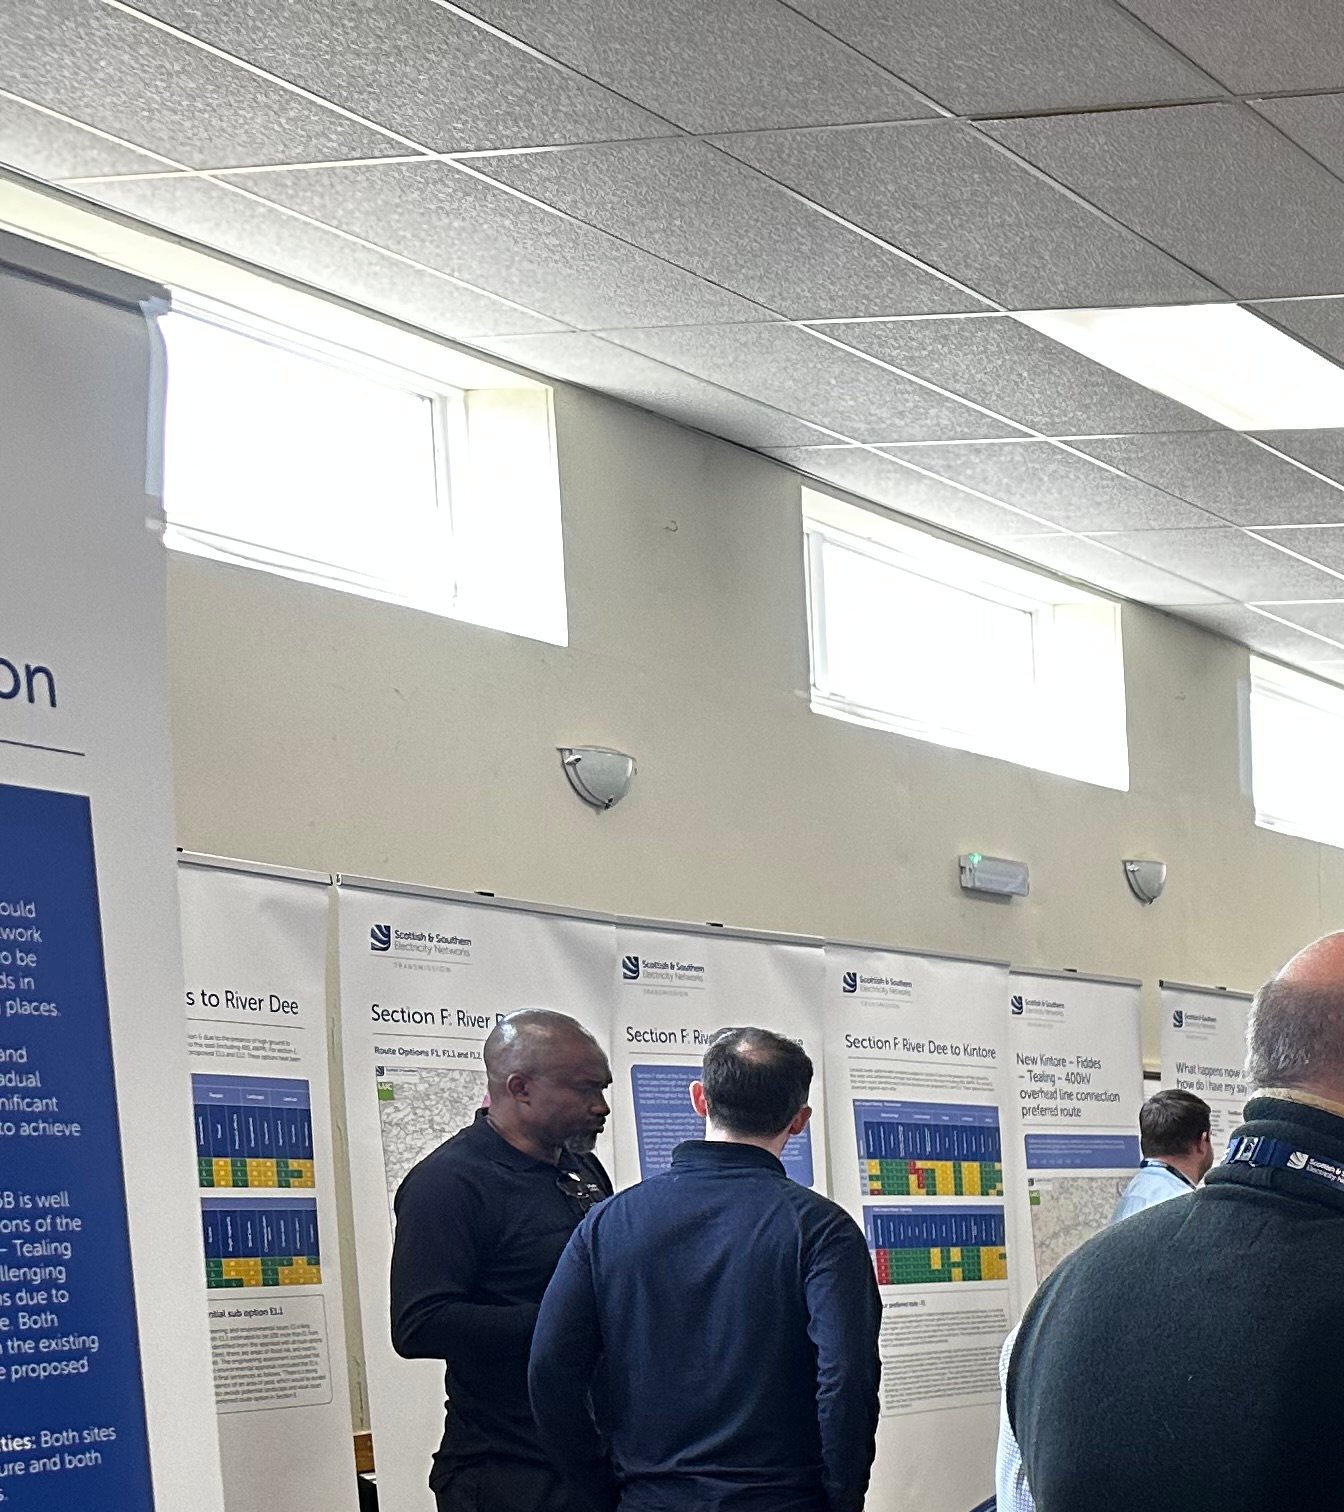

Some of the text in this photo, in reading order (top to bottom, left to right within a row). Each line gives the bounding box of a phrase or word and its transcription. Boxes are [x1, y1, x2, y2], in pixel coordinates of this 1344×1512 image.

[394, 929, 427, 942] Scottish
[435, 933, 472, 946] Southern
[394, 941, 470, 957] Electricity Networks
[6, 998, 61, 1017] places.
[201, 988, 299, 1015] to River Dee
[371, 1003, 490, 1029] Section F: River
[626, 1026, 677, 1044] Section
[374, 1046, 429, 1059] Route Options
[845, 1033, 996, 1059] Section River Dee to Kintore
[1016, 1052, 1101, 1070] New Kintore Fiddes
[1176, 1061, 1196, 1074] What
[1223, 1067, 1241, 1078] now
[1027, 1070, 1091, 1086] Tealing 400kV
[1176, 1078, 1193, 1090] how
[1020, 1088, 1120, 1103] overhead line connection
[1021, 1105, 1082, 1119] preferred route
[20, 1118, 81, 1137] achieve
[35, 1190, 70, 1208] well
[14, 1239, 72, 1260] Tealing
[244, 1308, 269, 1318] option
[39, 1333, 99, 1353] existing
[11, 1355, 89, 1383] proposed
[40, 1425, 117, 1449] Both sites
